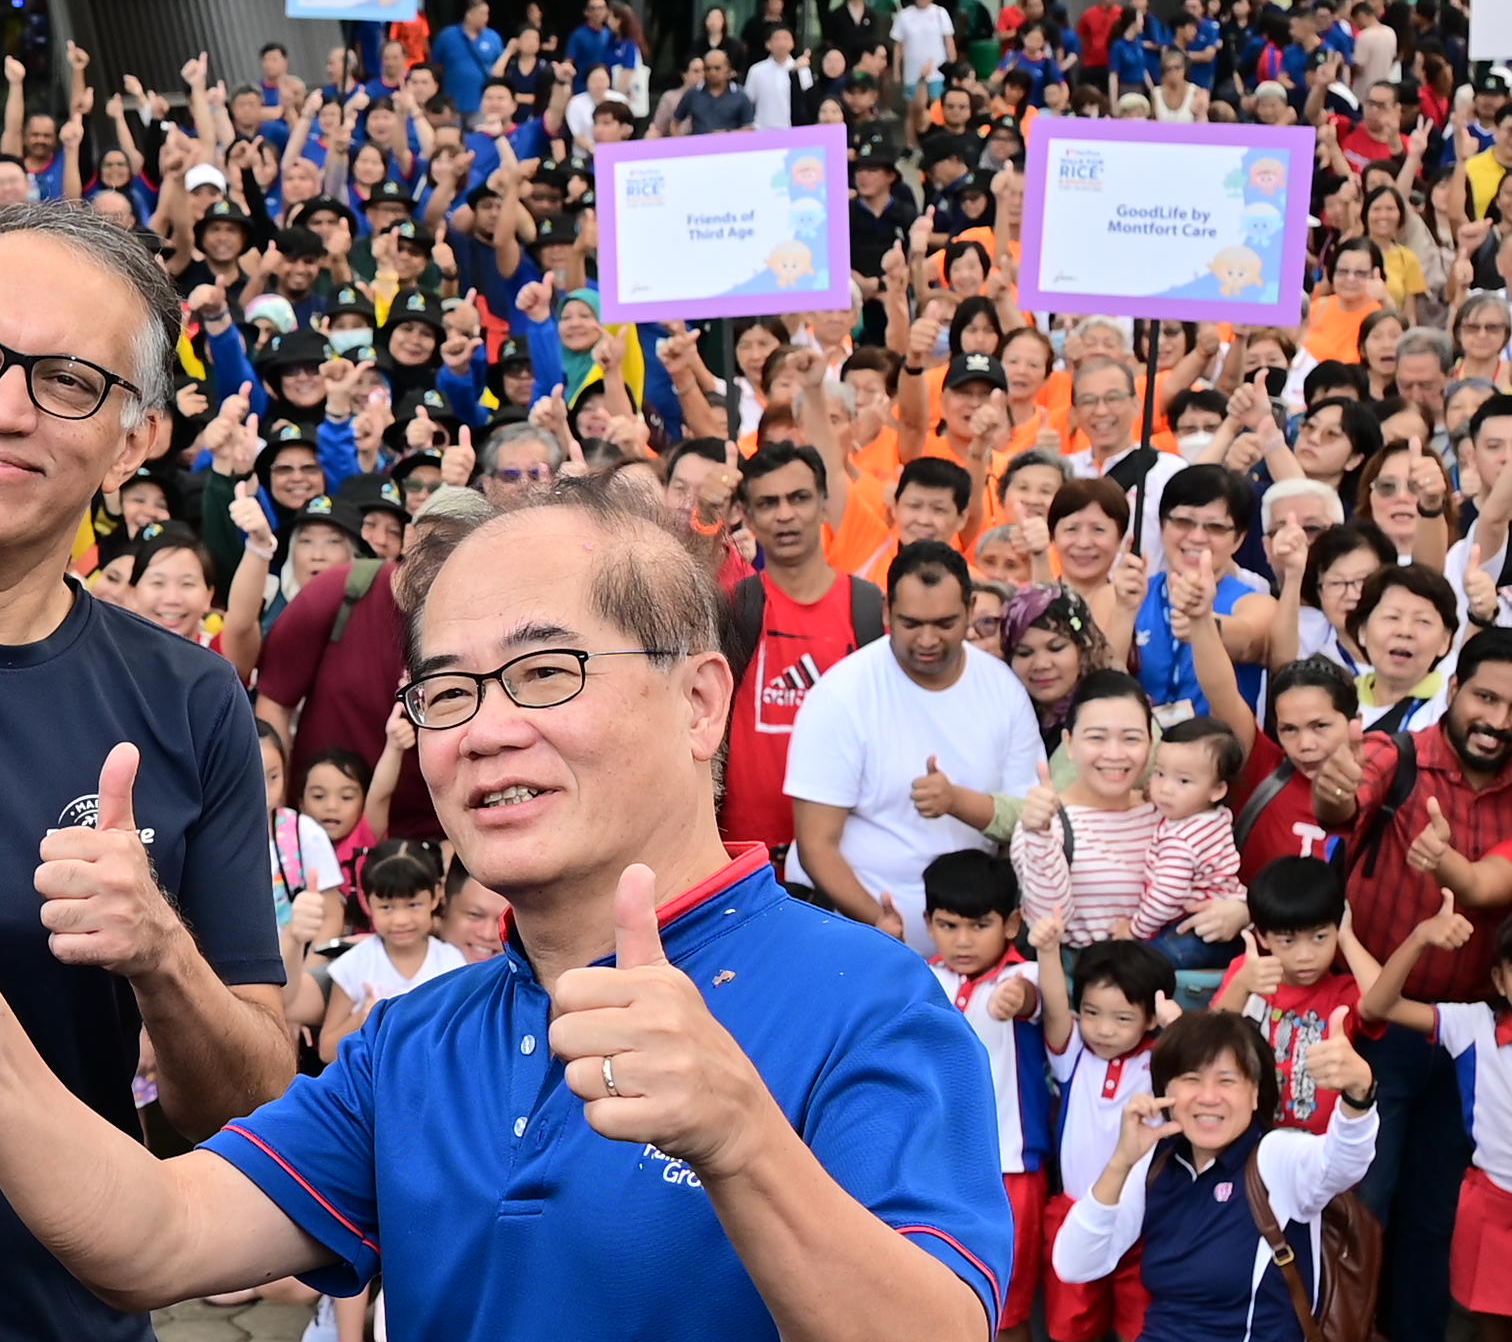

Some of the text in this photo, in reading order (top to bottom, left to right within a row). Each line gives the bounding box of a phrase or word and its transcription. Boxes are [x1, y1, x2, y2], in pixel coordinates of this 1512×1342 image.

[687, 210, 755, 226] Friends of
[1116, 203, 1211, 225] GoodLife by
[688, 226, 755, 241] Third Age
[1107, 219, 1218, 238] Montfort Care
